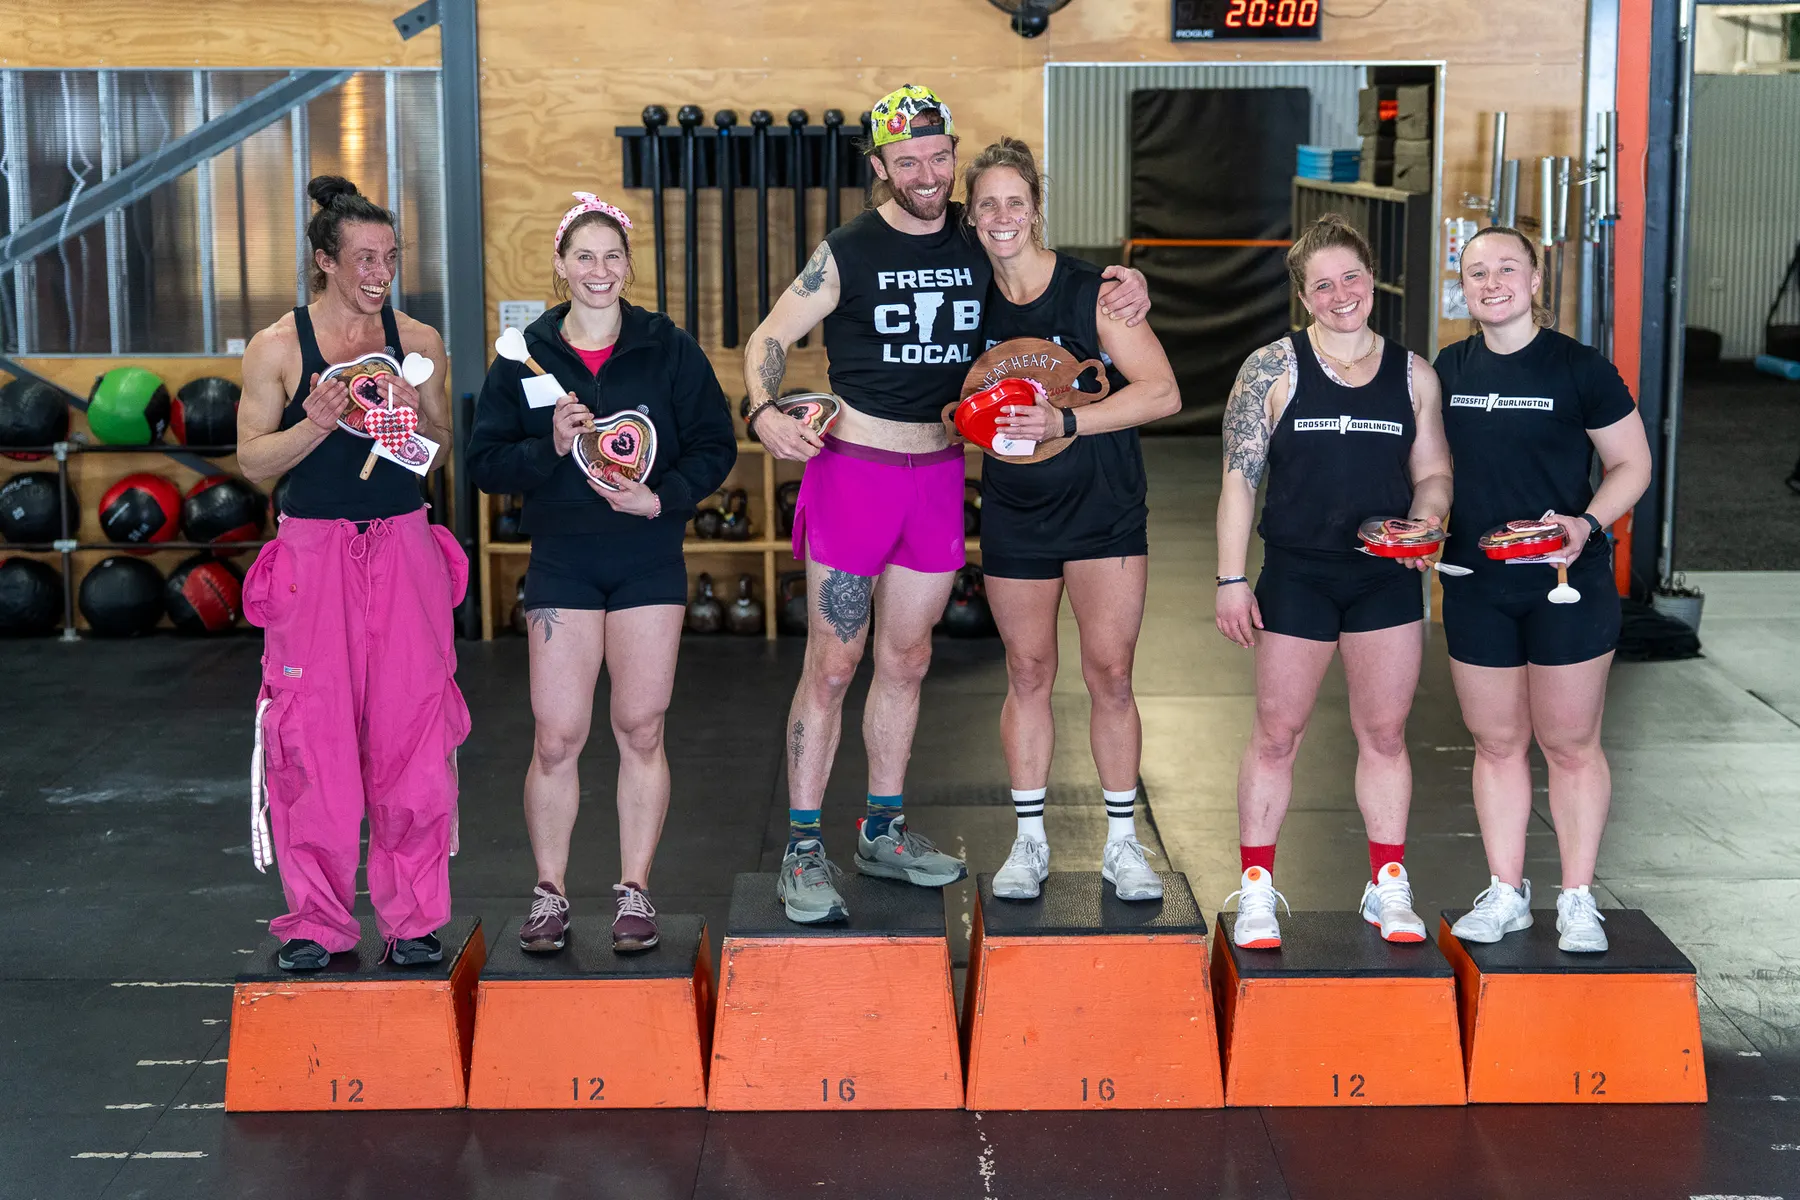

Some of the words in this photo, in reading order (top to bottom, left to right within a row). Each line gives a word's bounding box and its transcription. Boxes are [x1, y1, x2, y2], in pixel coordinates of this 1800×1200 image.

[1225, 0, 1319, 27] 20:00
[1175, 29, 1215, 39] ROGUE
[877, 267, 973, 290] FRESH
[882, 343, 972, 364] LOCAL
[978, 354, 1062, 391] WEAT-HEART
[1453, 396, 1486, 405] CROSSFIT
[1498, 399, 1550, 408] BURLINGTON
[1297, 420, 1338, 428] CROSSFIT
[1351, 421, 1401, 433] BURLINGTON
[329, 1078, 364, 1103] 12
[571, 1076, 605, 1101] 12
[821, 1077, 856, 1102] 16
[1080, 1076, 1115, 1101] 16
[1331, 1073, 1366, 1098] 12
[1572, 1070, 1607, 1096] 12
